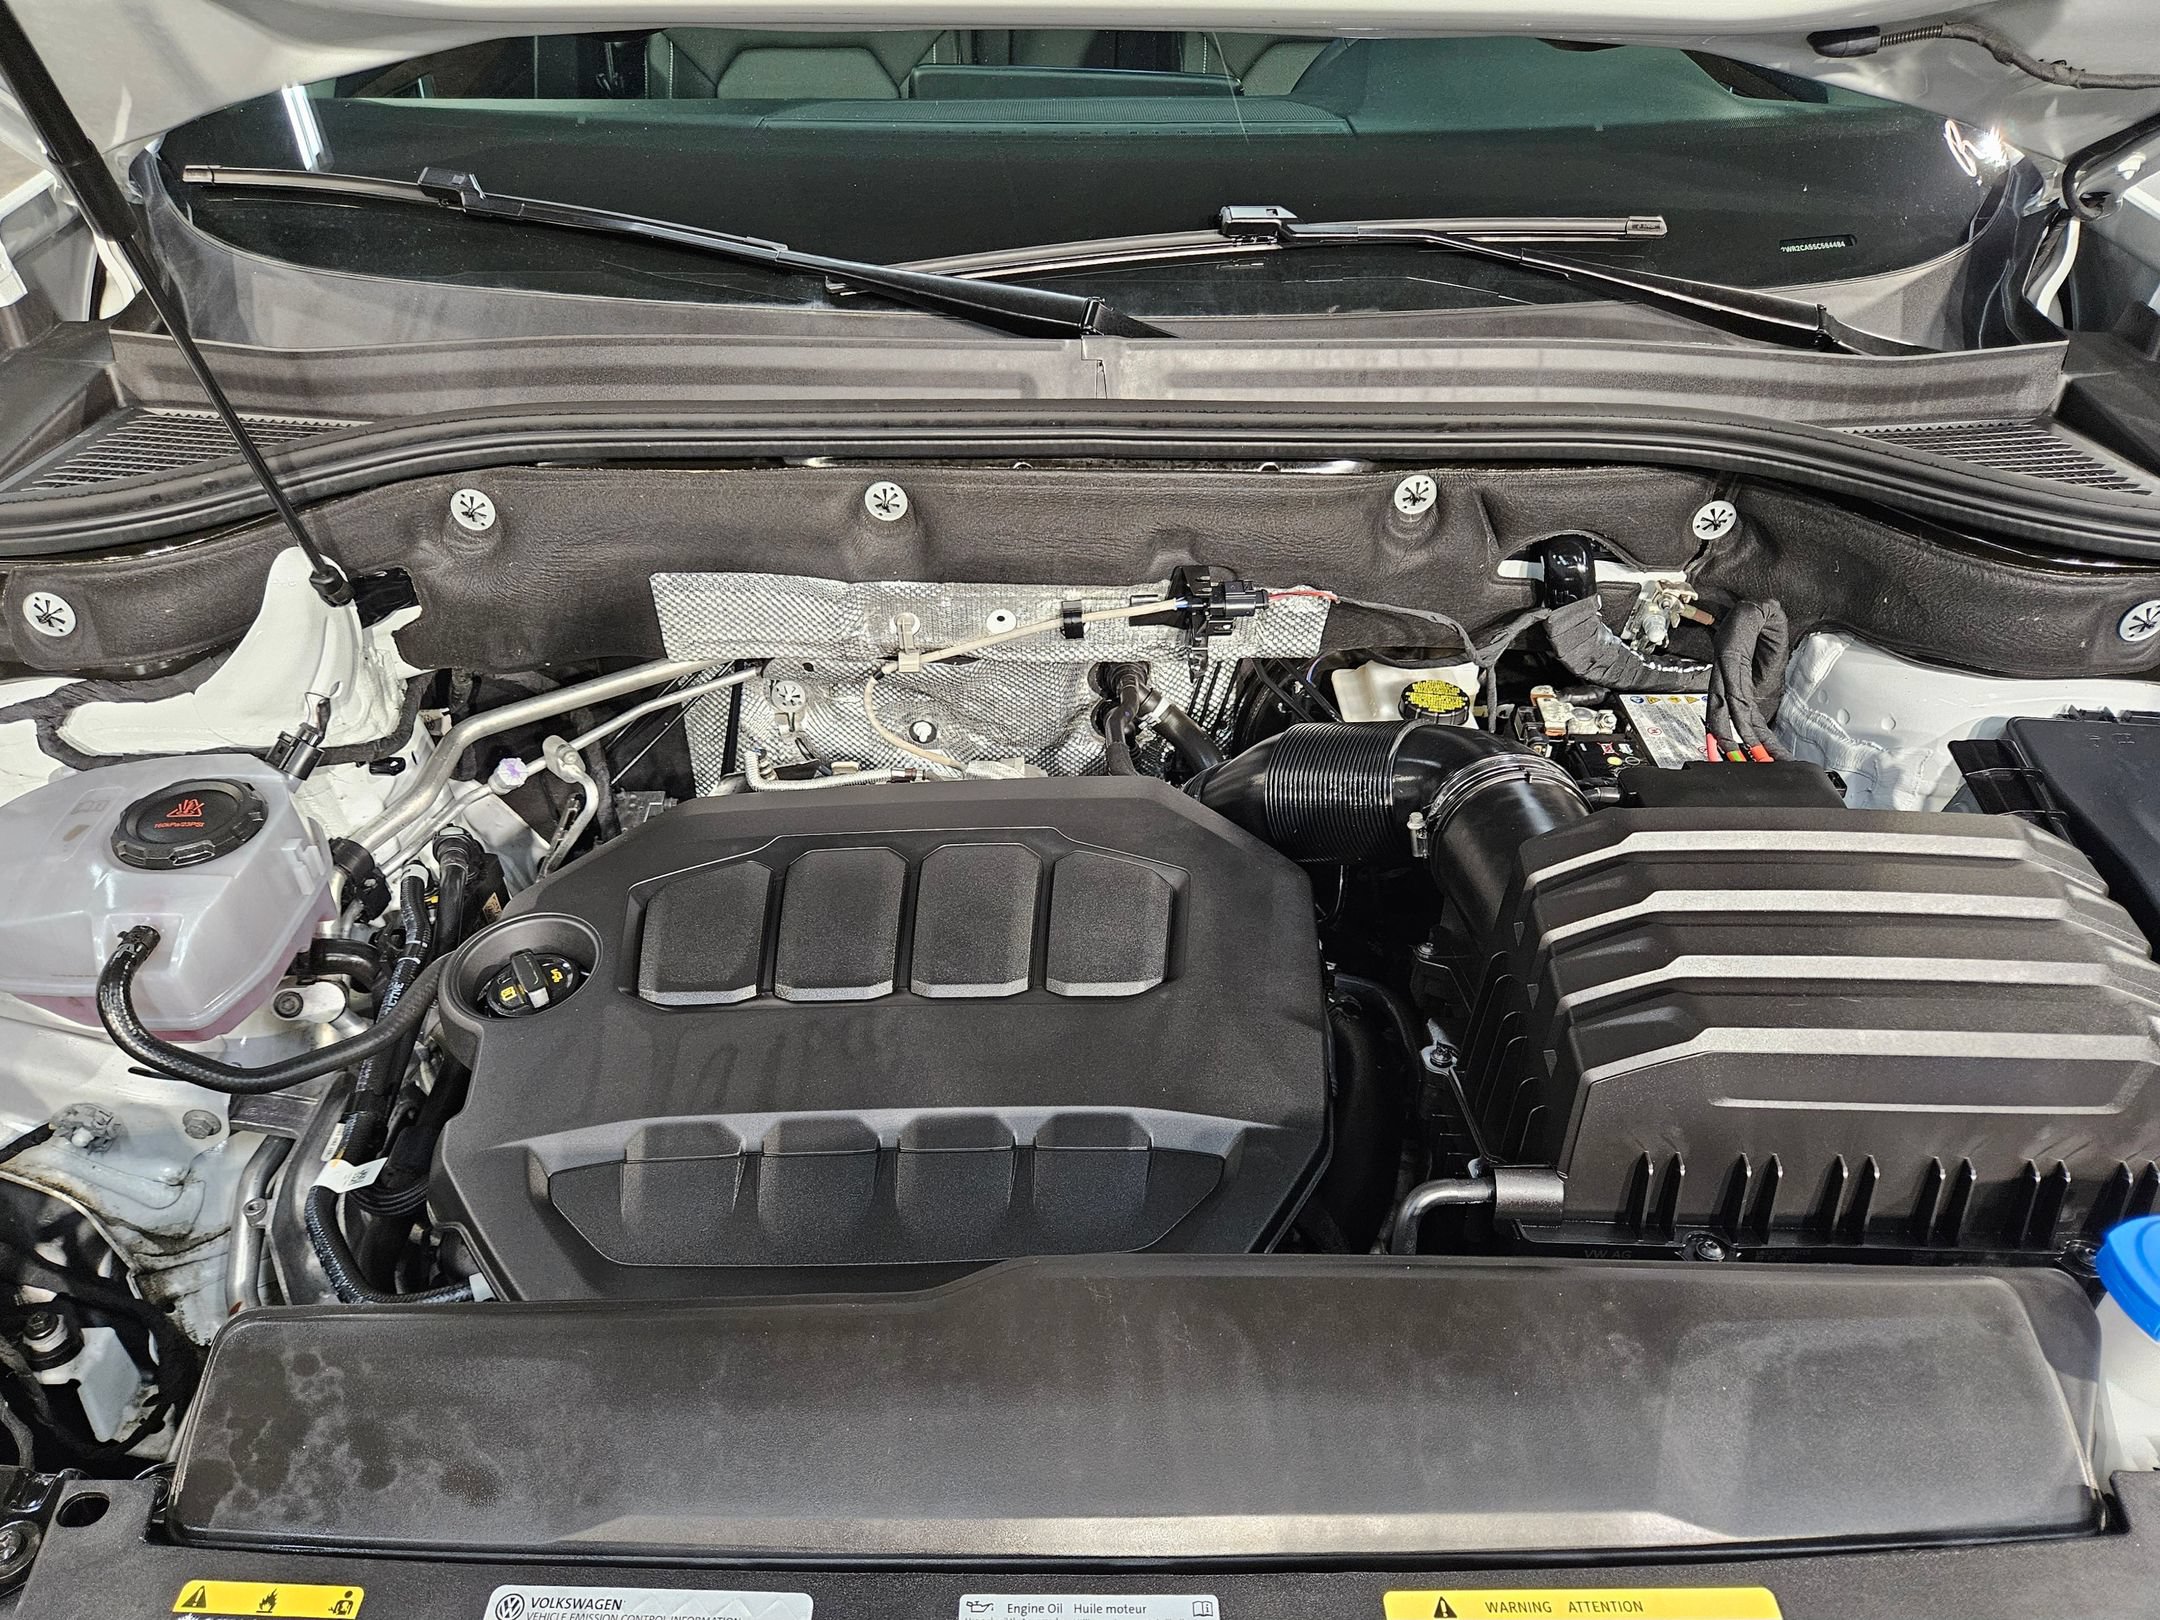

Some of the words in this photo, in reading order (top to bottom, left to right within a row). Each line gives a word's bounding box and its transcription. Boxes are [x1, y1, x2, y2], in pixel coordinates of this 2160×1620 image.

[531, 1597, 623, 1611] VOLKSWAGEN
[1007, 1603, 1044, 1616] Engine
[1048, 1603, 1063, 1613] Oil
[1073, 1603, 1103, 1614] Huile
[1106, 1605, 1147, 1614] moteur
[1485, 1601, 1552, 1613] WARNING
[1568, 1601, 1643, 1613] ATTENTION
[526, 1612, 567, 1620] VEHICLE
